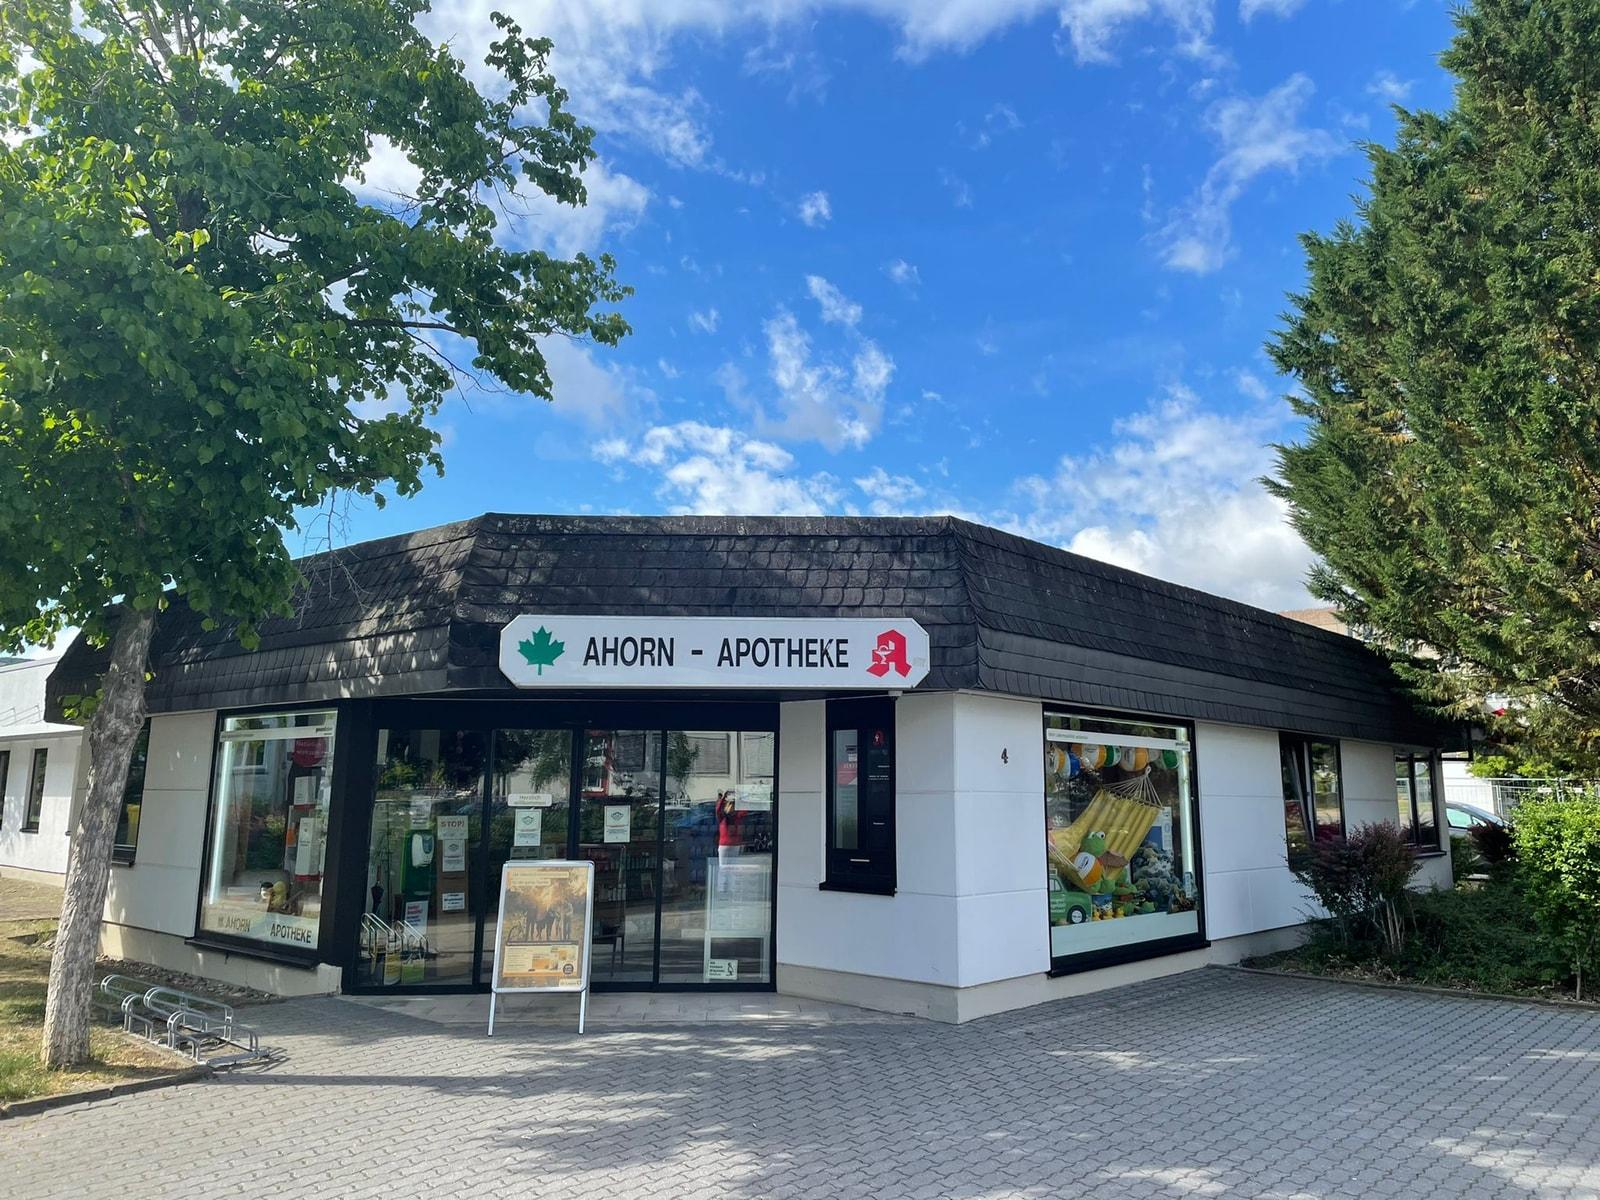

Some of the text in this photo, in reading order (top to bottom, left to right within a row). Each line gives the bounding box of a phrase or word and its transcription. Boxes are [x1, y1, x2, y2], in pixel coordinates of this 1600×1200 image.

[583, 636, 675, 666] AHORN
[717, 637, 849, 668] APOTHEKE
[1001, 747, 1009, 764] 4
[270, 923, 312, 943] APOTHEKE
